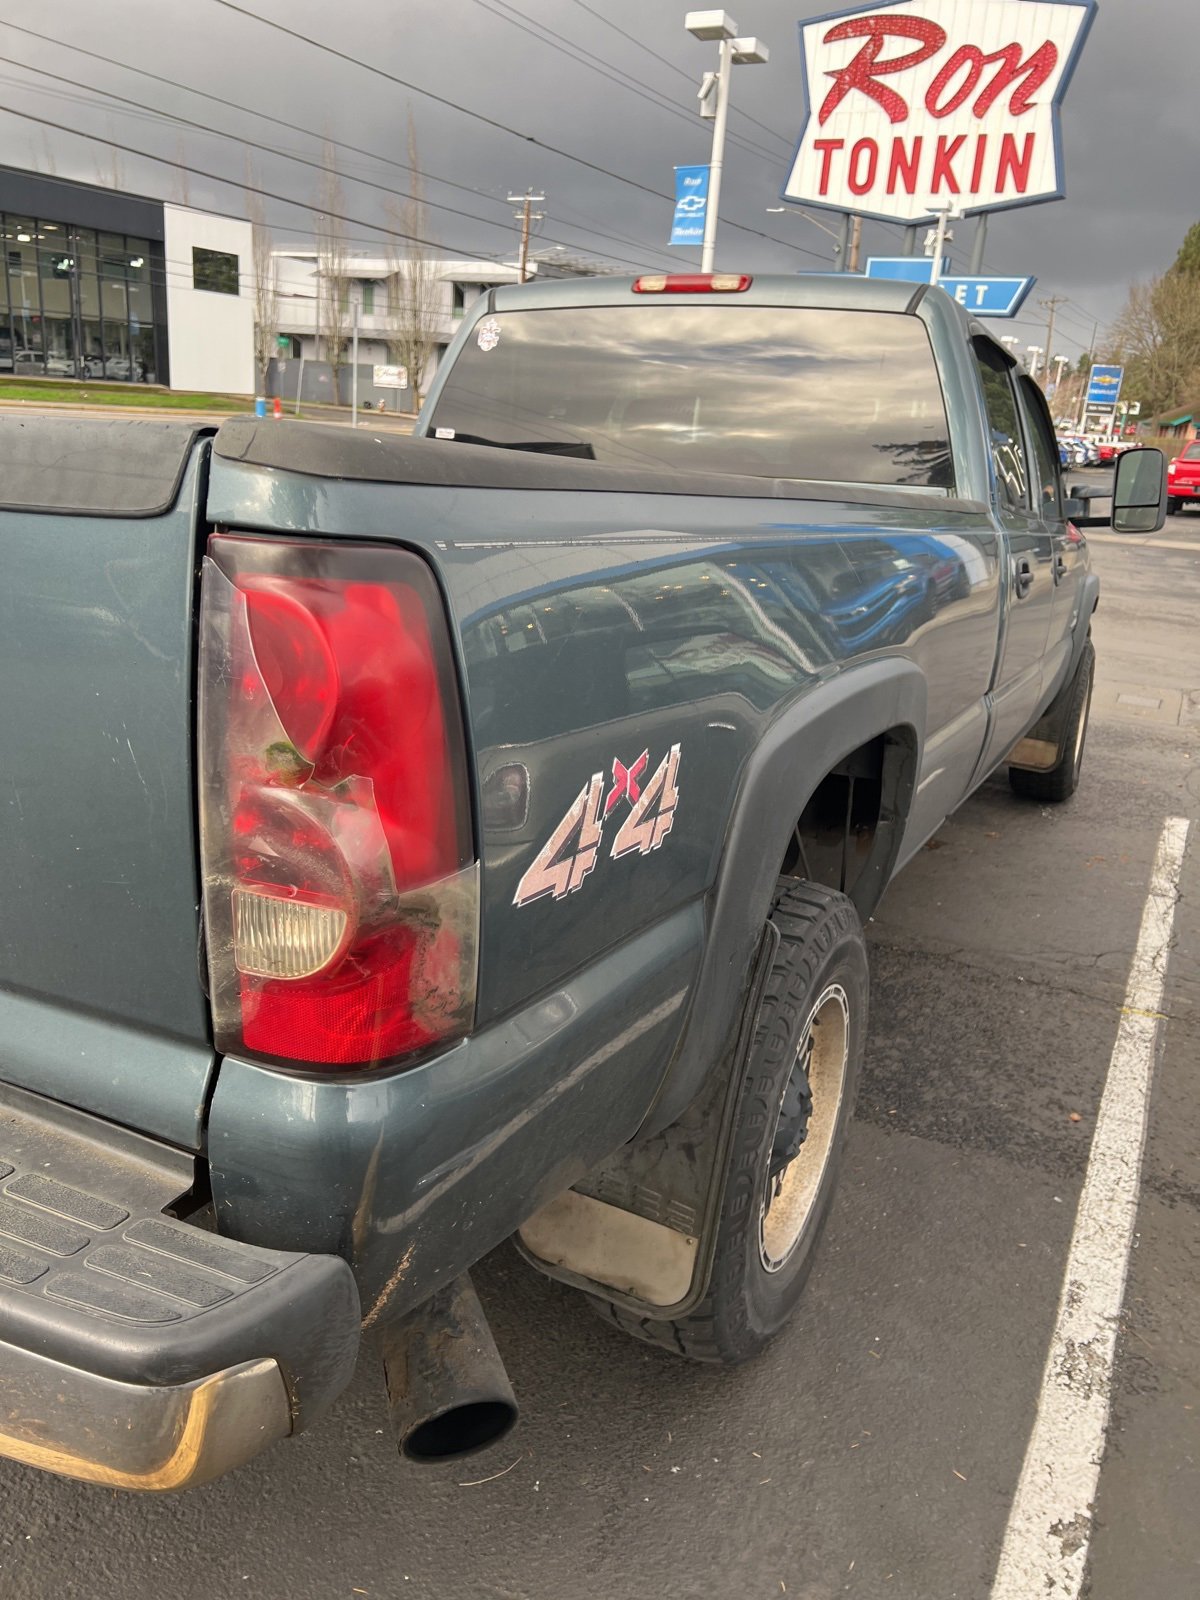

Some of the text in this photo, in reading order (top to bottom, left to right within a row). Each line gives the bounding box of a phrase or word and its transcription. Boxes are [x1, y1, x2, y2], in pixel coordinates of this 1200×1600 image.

[818, 14, 1058, 127] Ron
[813, 132, 1036, 196] TONKIN
[939, 284, 989, 306] ET
